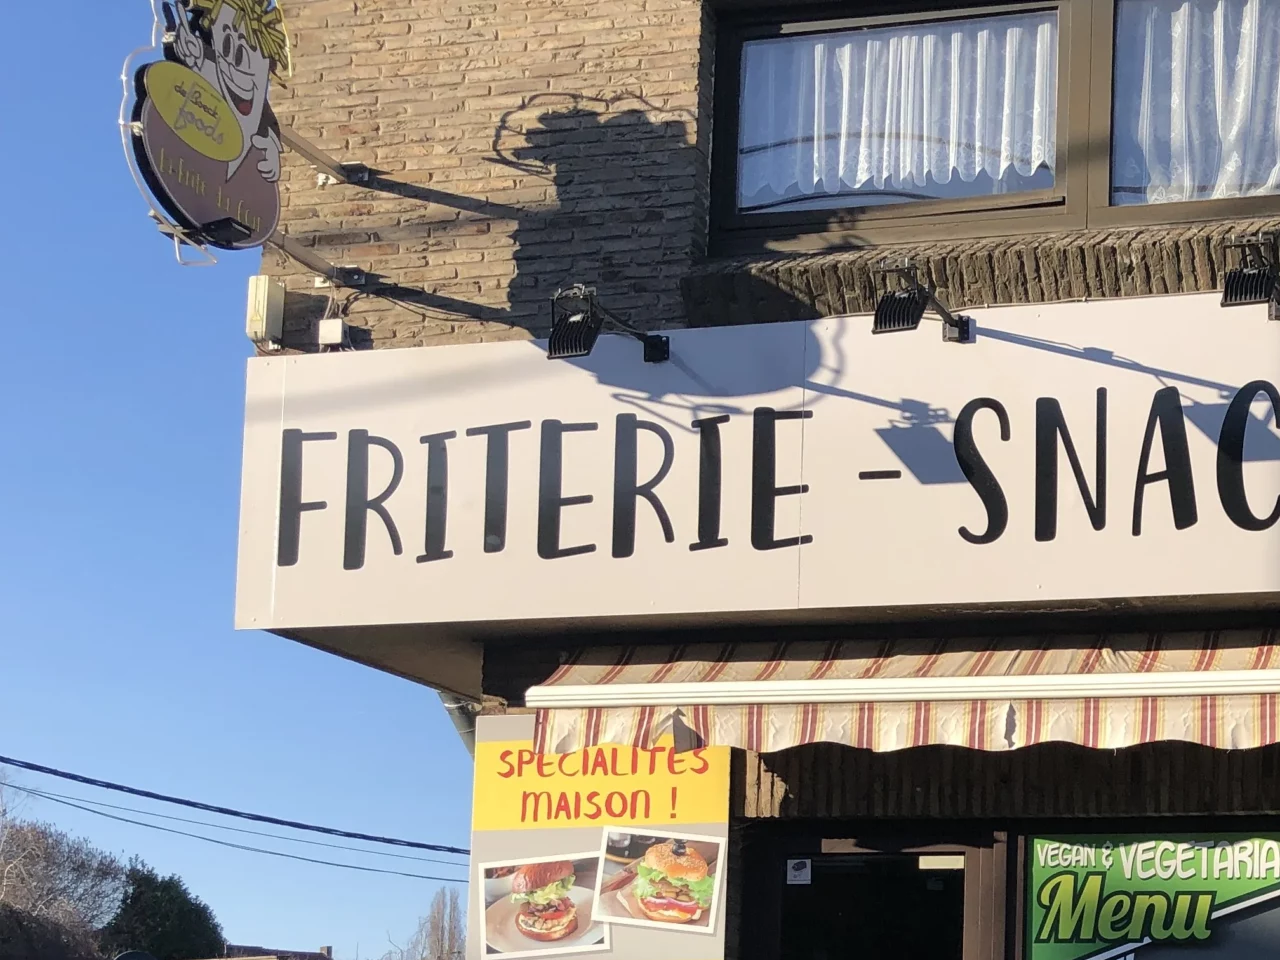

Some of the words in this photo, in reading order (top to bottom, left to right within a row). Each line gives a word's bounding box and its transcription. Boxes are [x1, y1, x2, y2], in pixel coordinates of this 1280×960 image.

[277, 406, 814, 571] FRITERIE
[520, 789, 651, 823] MAISON
[1037, 843, 1097, 868] VEGAN
[1101, 841, 1114, 870] &
[1036, 872, 1215, 942] Menu
